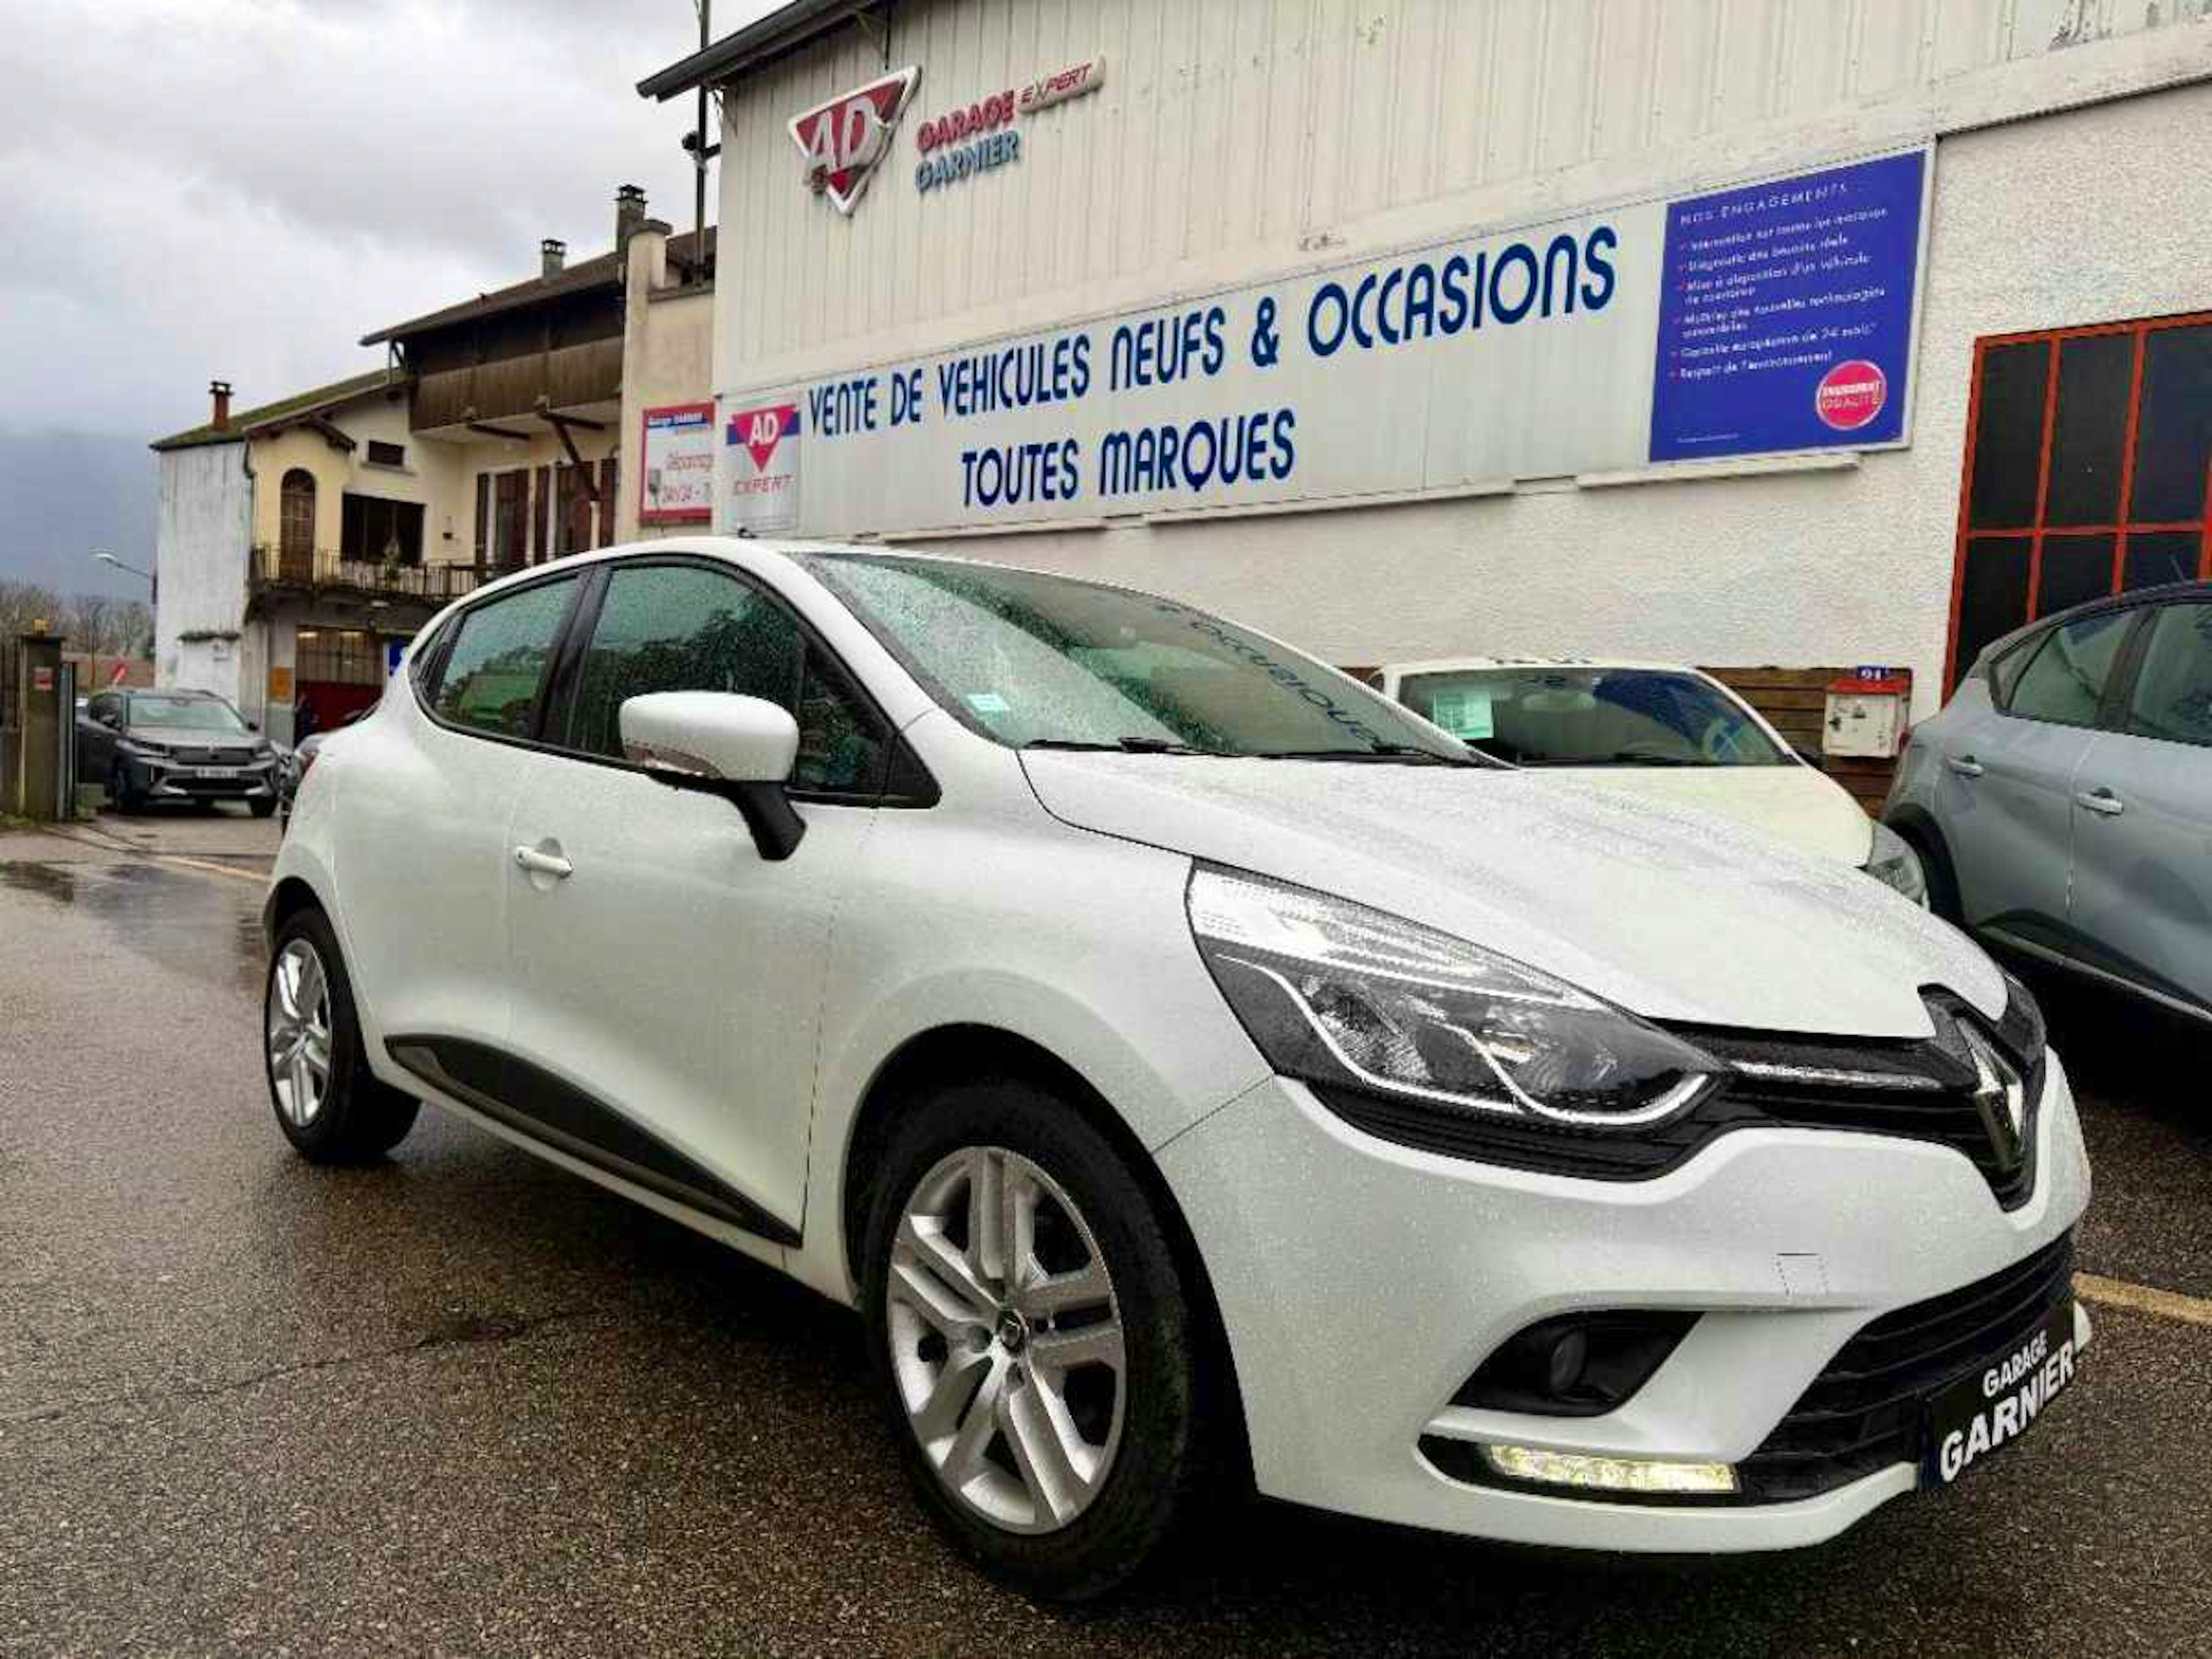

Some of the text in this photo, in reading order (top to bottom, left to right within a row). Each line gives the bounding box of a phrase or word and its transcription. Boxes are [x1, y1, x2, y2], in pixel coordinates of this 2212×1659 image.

[1021, 63, 1092, 104] EXPERT
[808, 96, 886, 174] AD
[919, 90, 1014, 153] GARAGE
[916, 131, 1018, 191] GARNIER
[1720, 183, 1847, 218] ENGAGEMENTS
[809, 226, 1618, 435] VENTE DE VEHICULES NEUFS & OCCASIONS
[750, 411, 778, 447] AD
[961, 408, 1295, 507] TOUTES MARQUES
[1983, 1330, 2047, 1397] GARAGE
[1940, 1339, 2074, 1482] GARNIER
